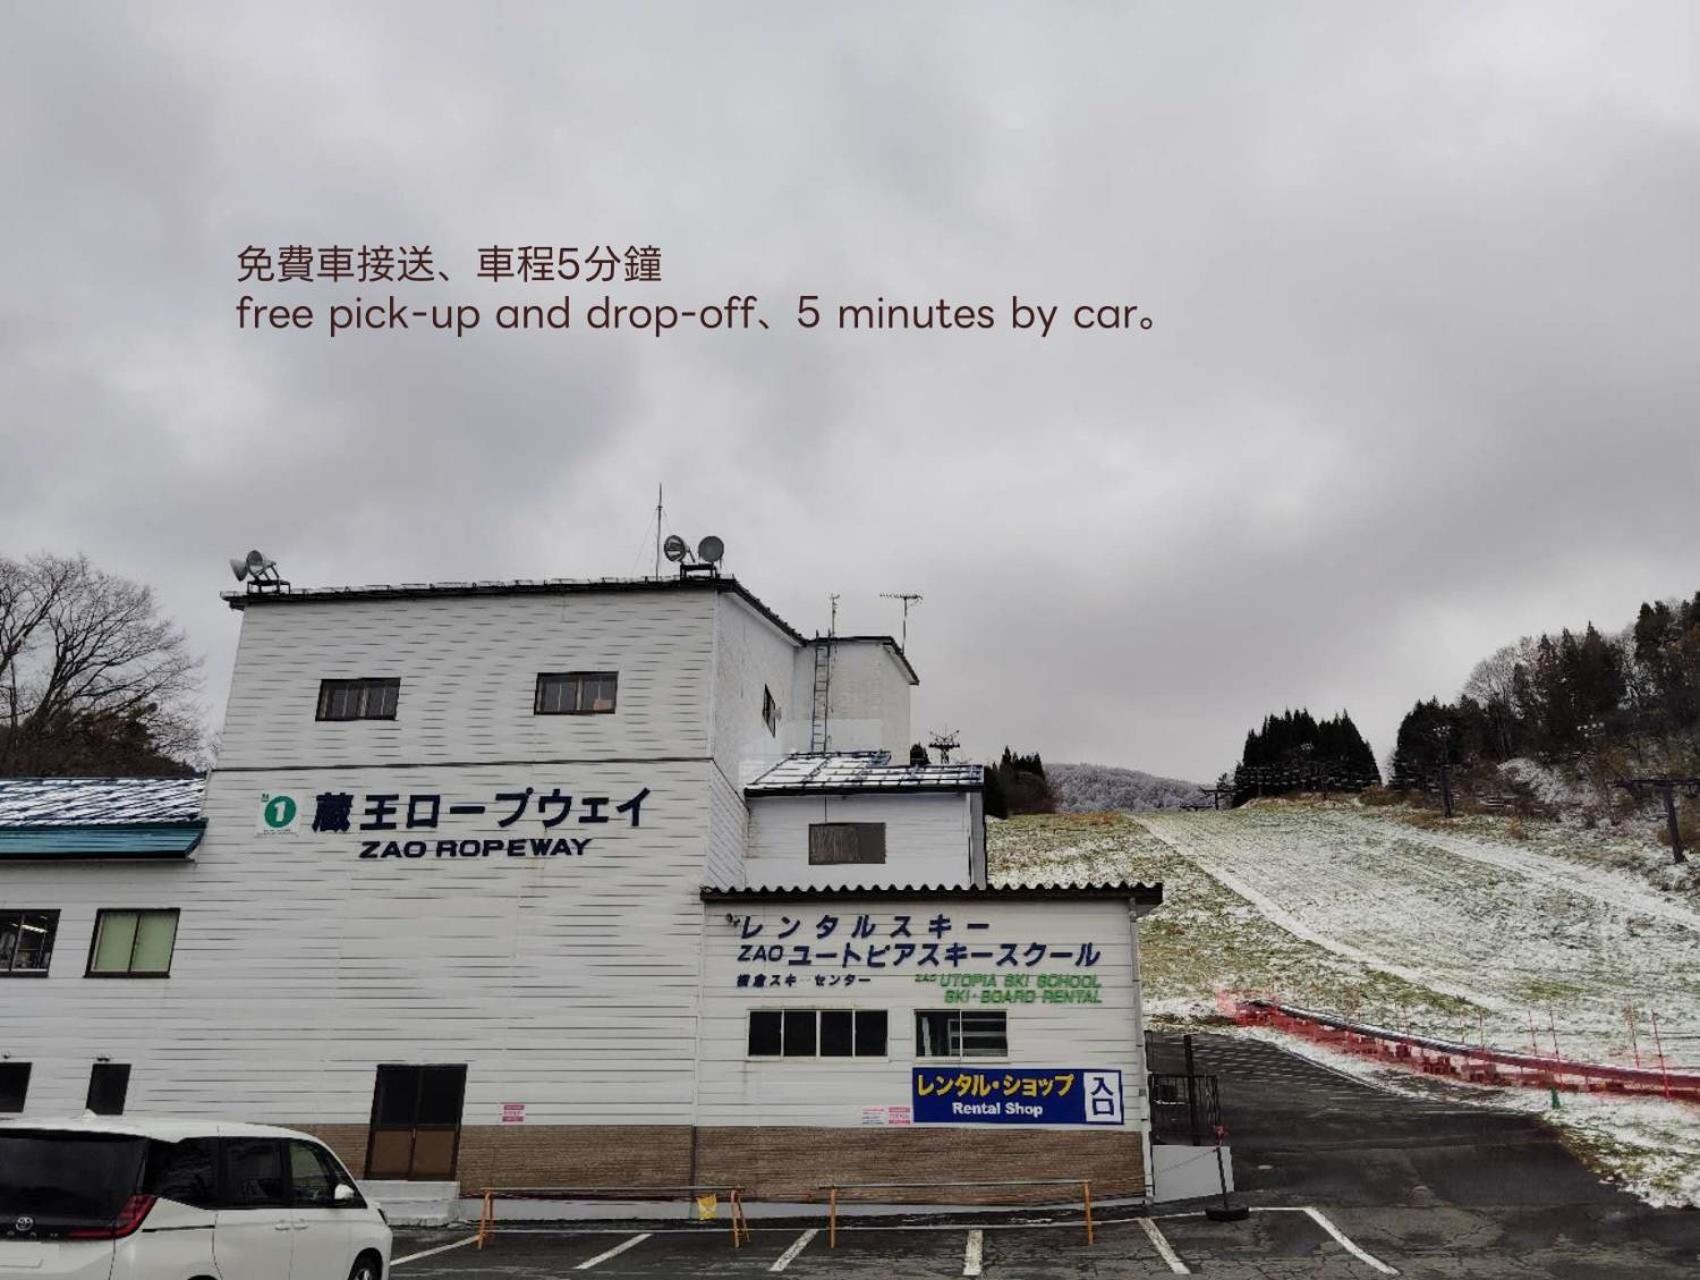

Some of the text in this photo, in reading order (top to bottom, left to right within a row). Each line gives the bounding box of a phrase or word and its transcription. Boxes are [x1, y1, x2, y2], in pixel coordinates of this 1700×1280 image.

[312, 786, 652, 834] 蔵王ロープウェイ
[358, 837, 593, 860] ZAO ROPEWAY
[739, 913, 990, 939] レンタルスキー
[939, 973, 998, 988] UTOPIA
[1003, 973, 1030, 988] SKI
[1036, 973, 1102, 988] SCHOOL
[1041, 989, 1103, 1004] RENTAL
[917, 1073, 1075, 1097] レンタル・ショップ
[1090, 1076, 1115, 1117] 入口
[952, 1102, 1043, 1118] Rental Shop
